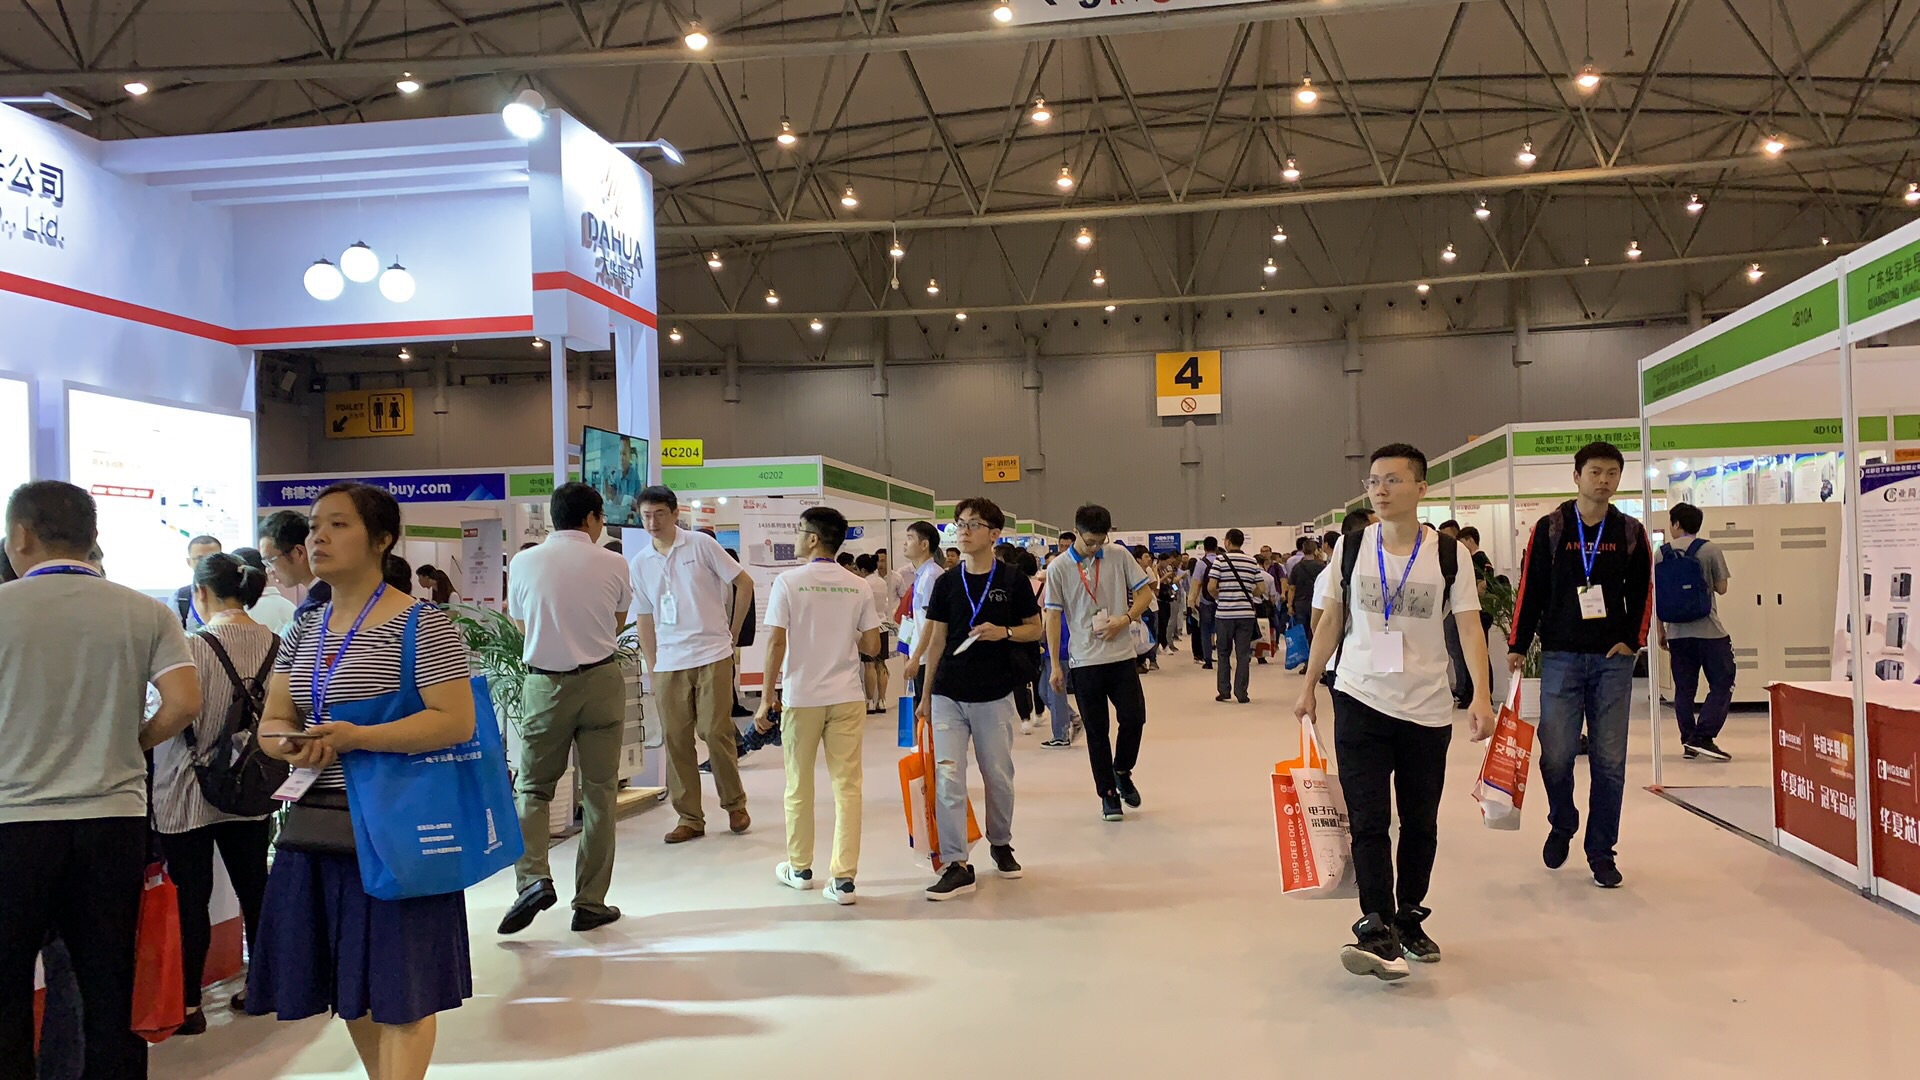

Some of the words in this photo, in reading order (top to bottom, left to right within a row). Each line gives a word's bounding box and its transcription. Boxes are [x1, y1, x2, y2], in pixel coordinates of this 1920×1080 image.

[0, 148, 63, 202] 公司
[586, 211, 644, 269] DAHUA
[600, 255, 634, 289] 大华电子
[1174, 356, 1203, 390] 4
[335, 403, 364, 412] TOILET
[661, 449, 700, 459] 4C204
[1535, 431, 1641, 446] 成都巴丁半导体有限公司
[1780, 769, 1815, 804] 华夏芯片
[1880, 806, 1920, 846] 华夏芯
